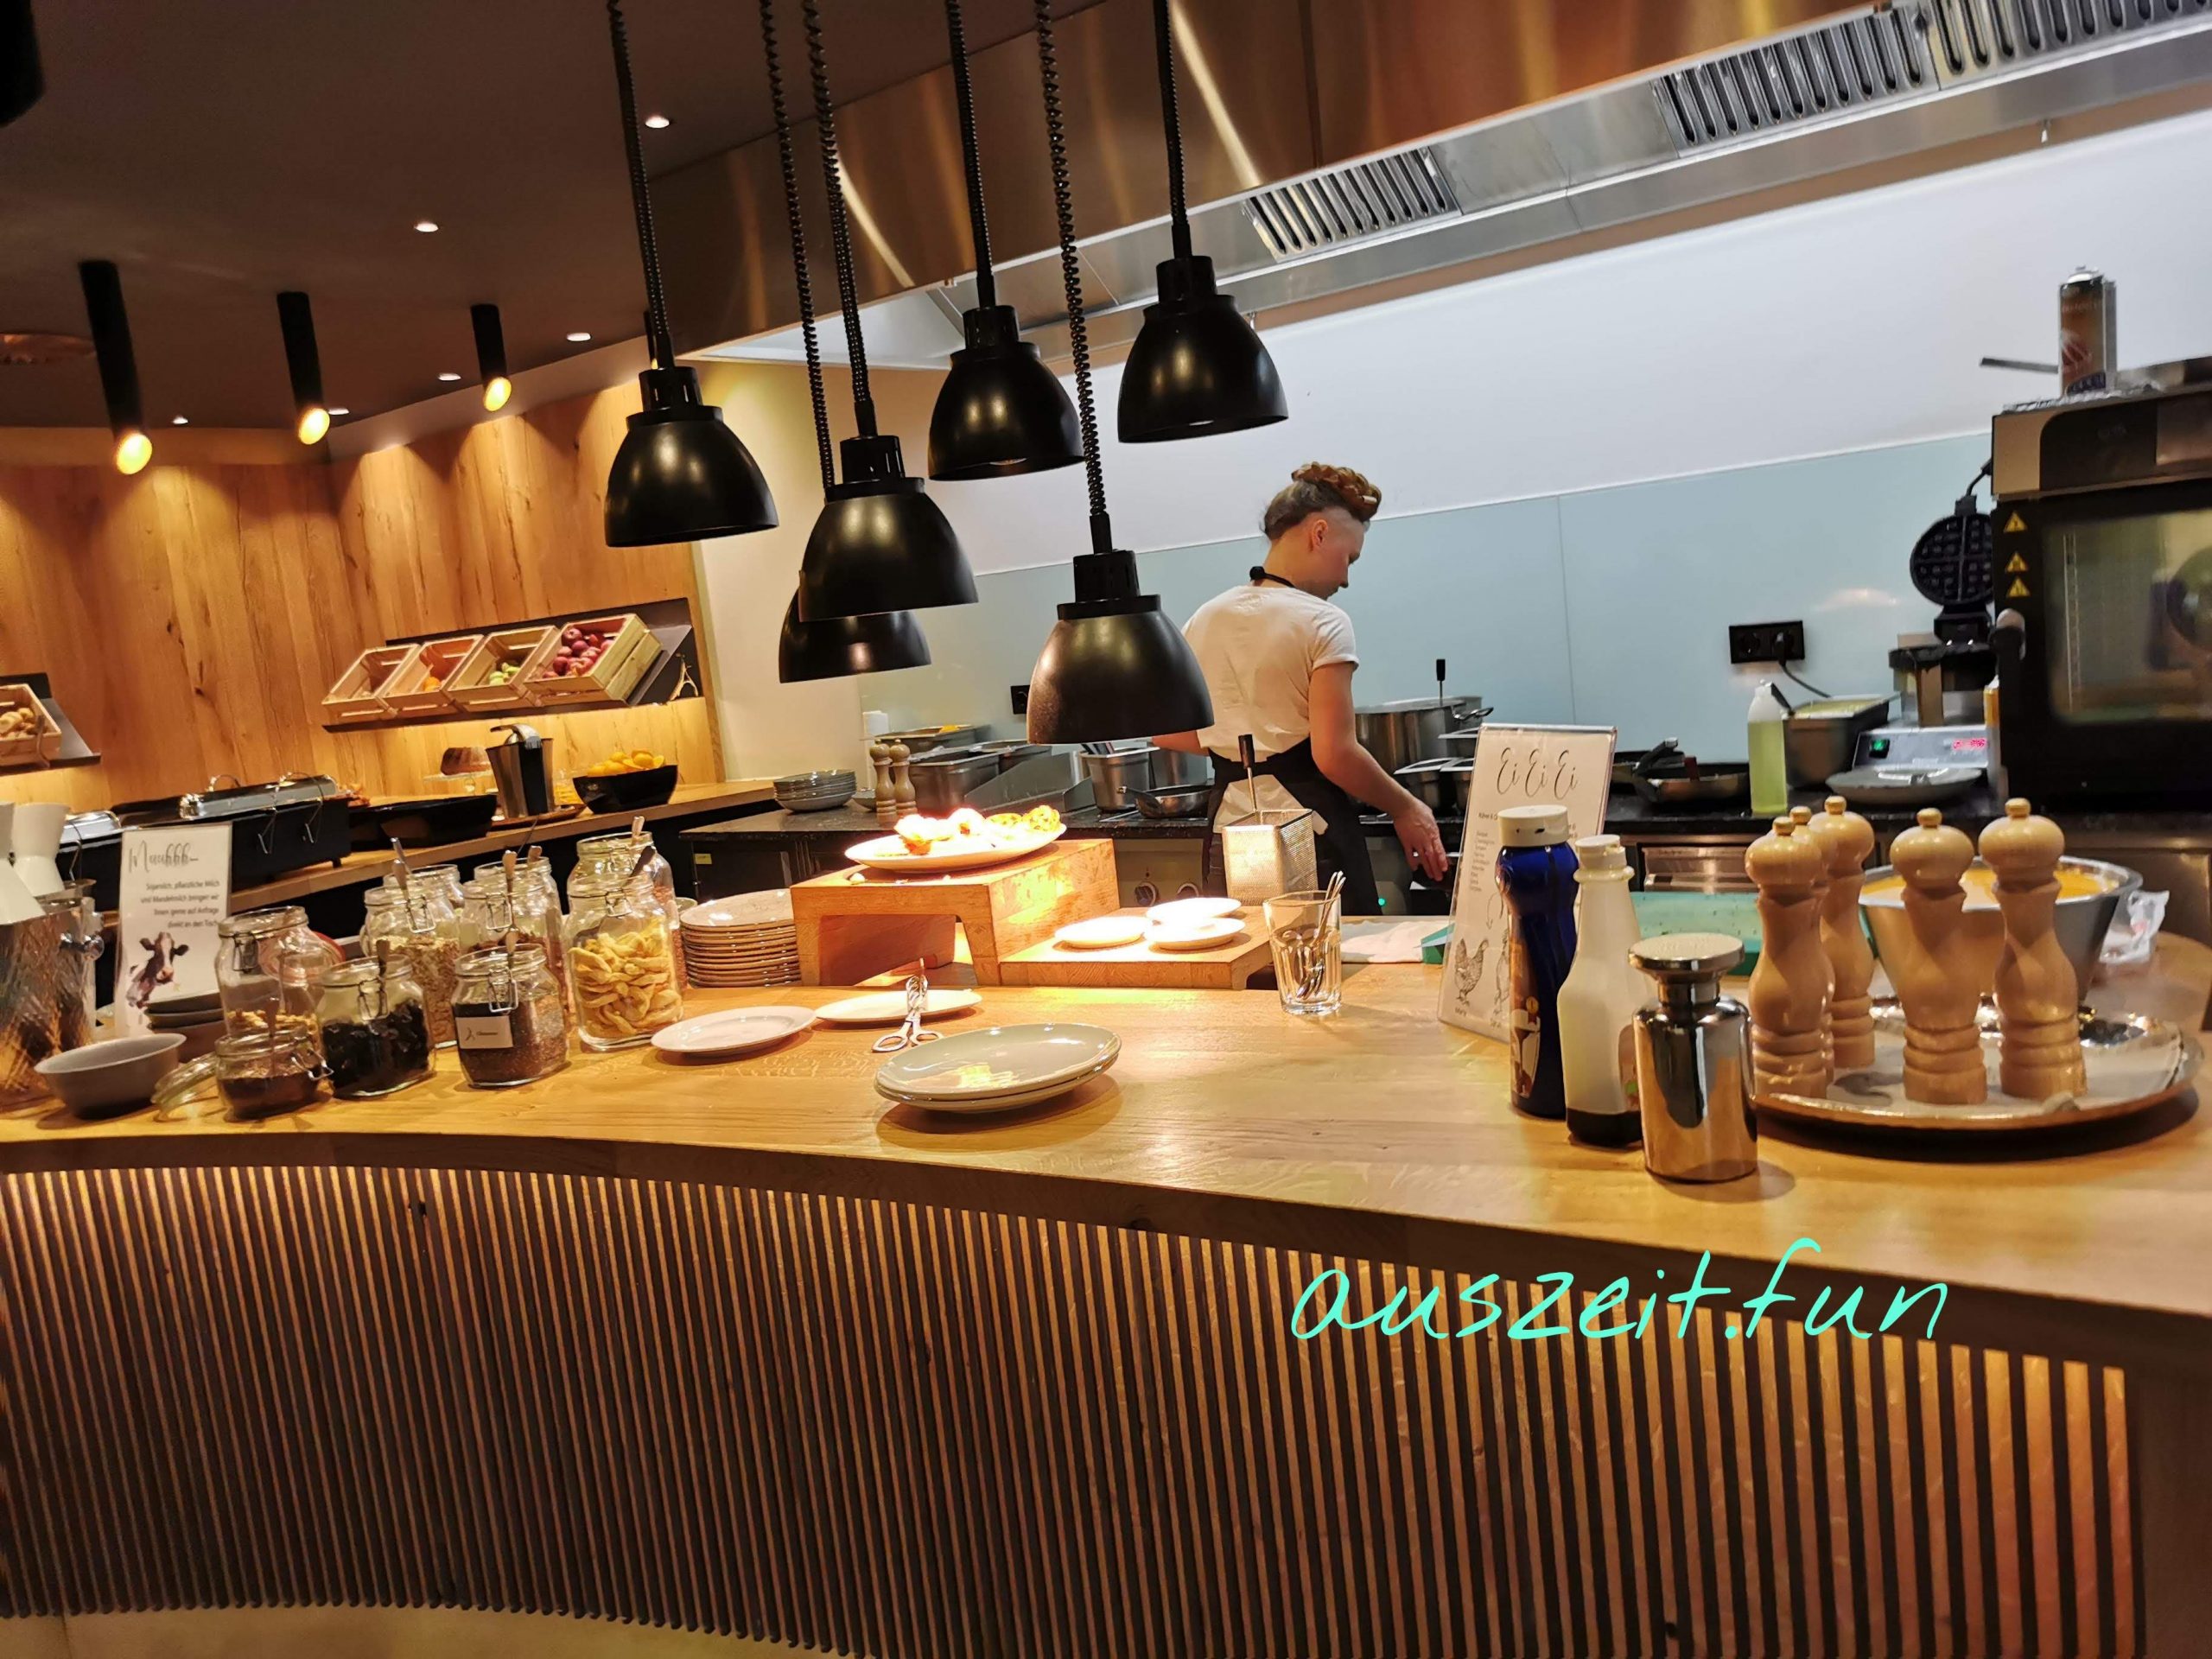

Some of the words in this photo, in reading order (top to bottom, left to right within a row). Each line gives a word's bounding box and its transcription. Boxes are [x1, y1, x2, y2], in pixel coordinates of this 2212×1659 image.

[1497, 747, 1521, 795] Ei
[1525, 747, 1548, 798] Ei
[1554, 749, 1579, 800] Ei
